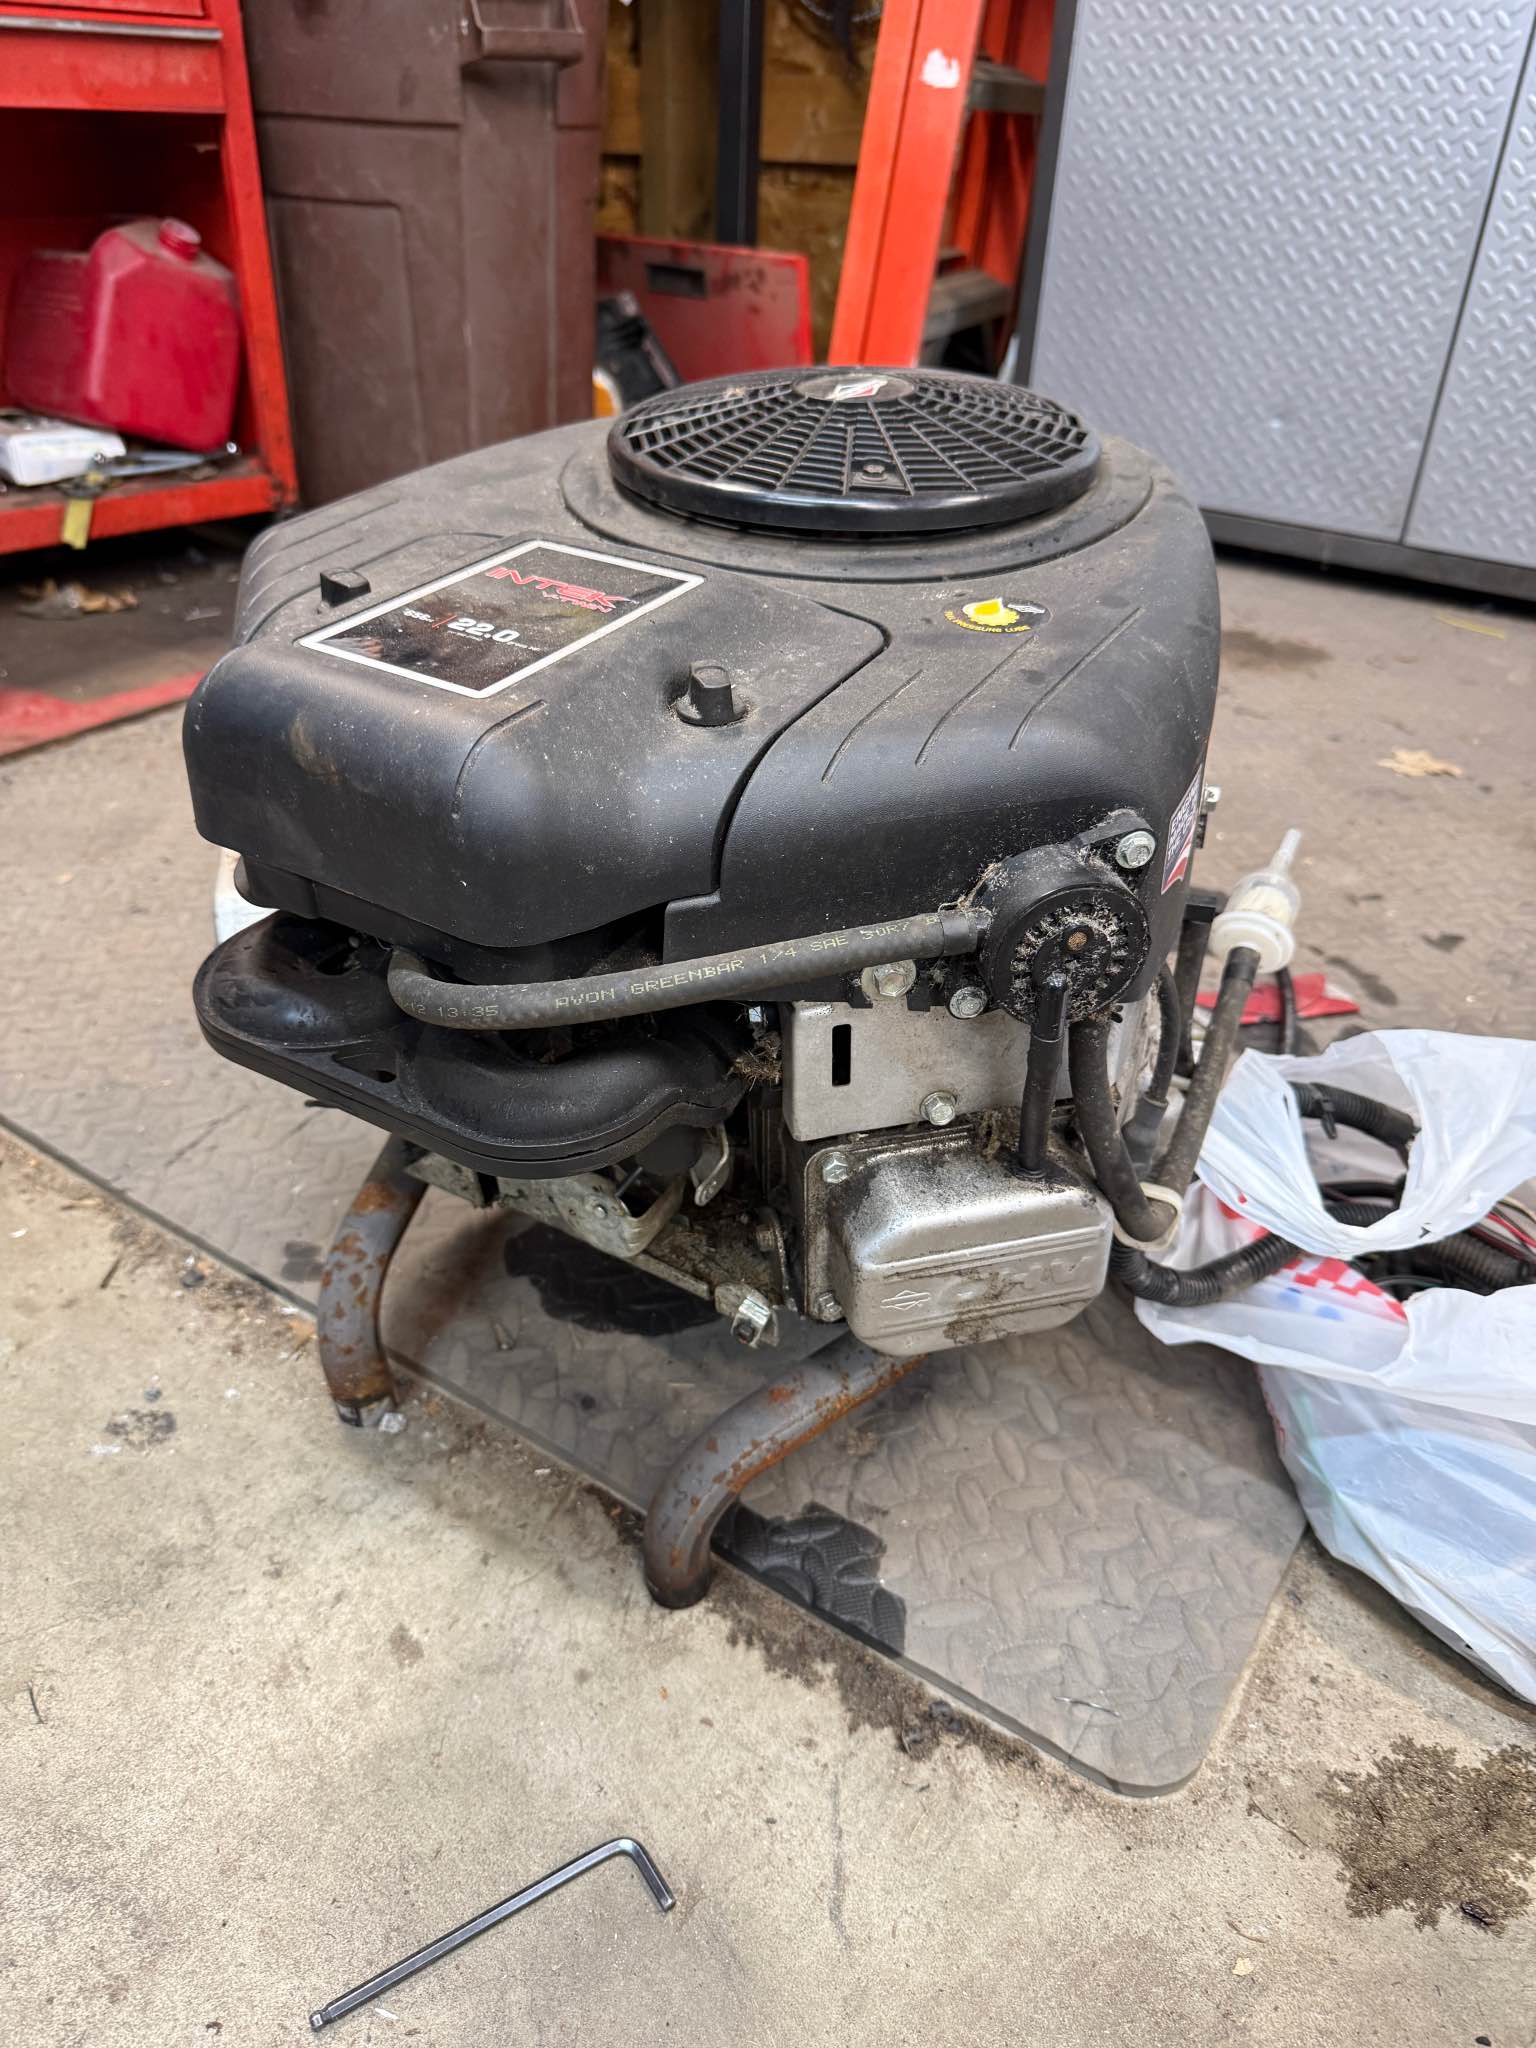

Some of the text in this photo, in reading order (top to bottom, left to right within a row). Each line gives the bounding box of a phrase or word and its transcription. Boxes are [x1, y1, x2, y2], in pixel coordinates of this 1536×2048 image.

[485, 567, 624, 609] INTEK
[447, 617, 520, 643] 22.0
[436, 1005, 499, 1018] 13:35
[555, 987, 615, 1009] AVON
[630, 959, 745, 995] GREENBAR
[760, 947, 797, 965] 1/4
[811, 934, 849, 952] SAE
